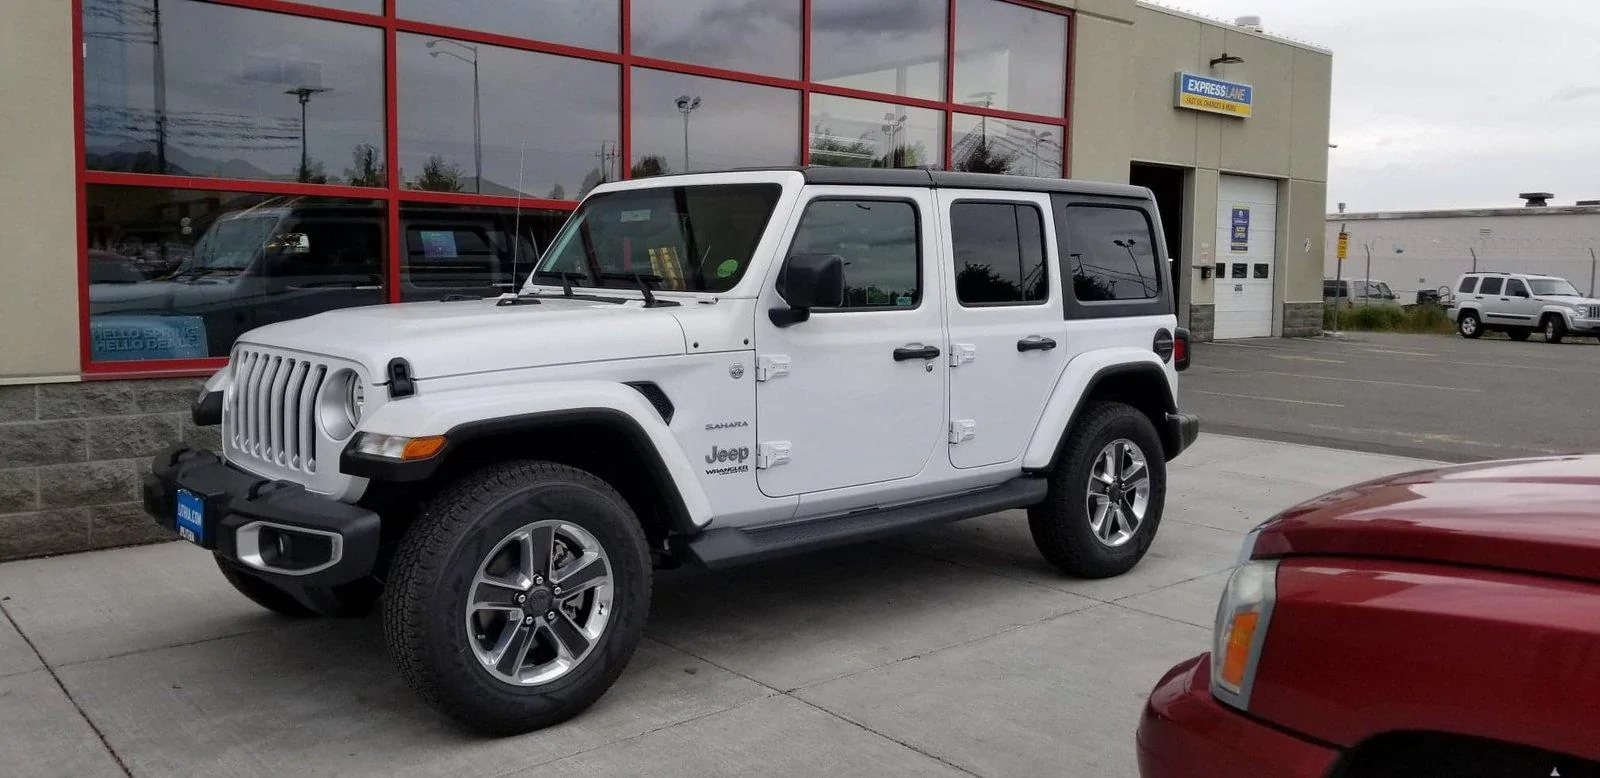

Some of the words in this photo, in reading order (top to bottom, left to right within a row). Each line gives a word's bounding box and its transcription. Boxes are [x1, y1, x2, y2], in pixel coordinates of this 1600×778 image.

[1186, 96, 1197, 105] FAST
[1204, 99, 1221, 109] CHANGES
[1226, 103, 1237, 111] MORE
[93, 327, 140, 339] HELLO
[144, 327, 198, 340] SPRING
[96, 338, 144, 351] HELLO
[705, 421, 749, 430] SAHARA
[705, 446, 749, 463] Jeep
[705, 465, 749, 474] WRANGLER
